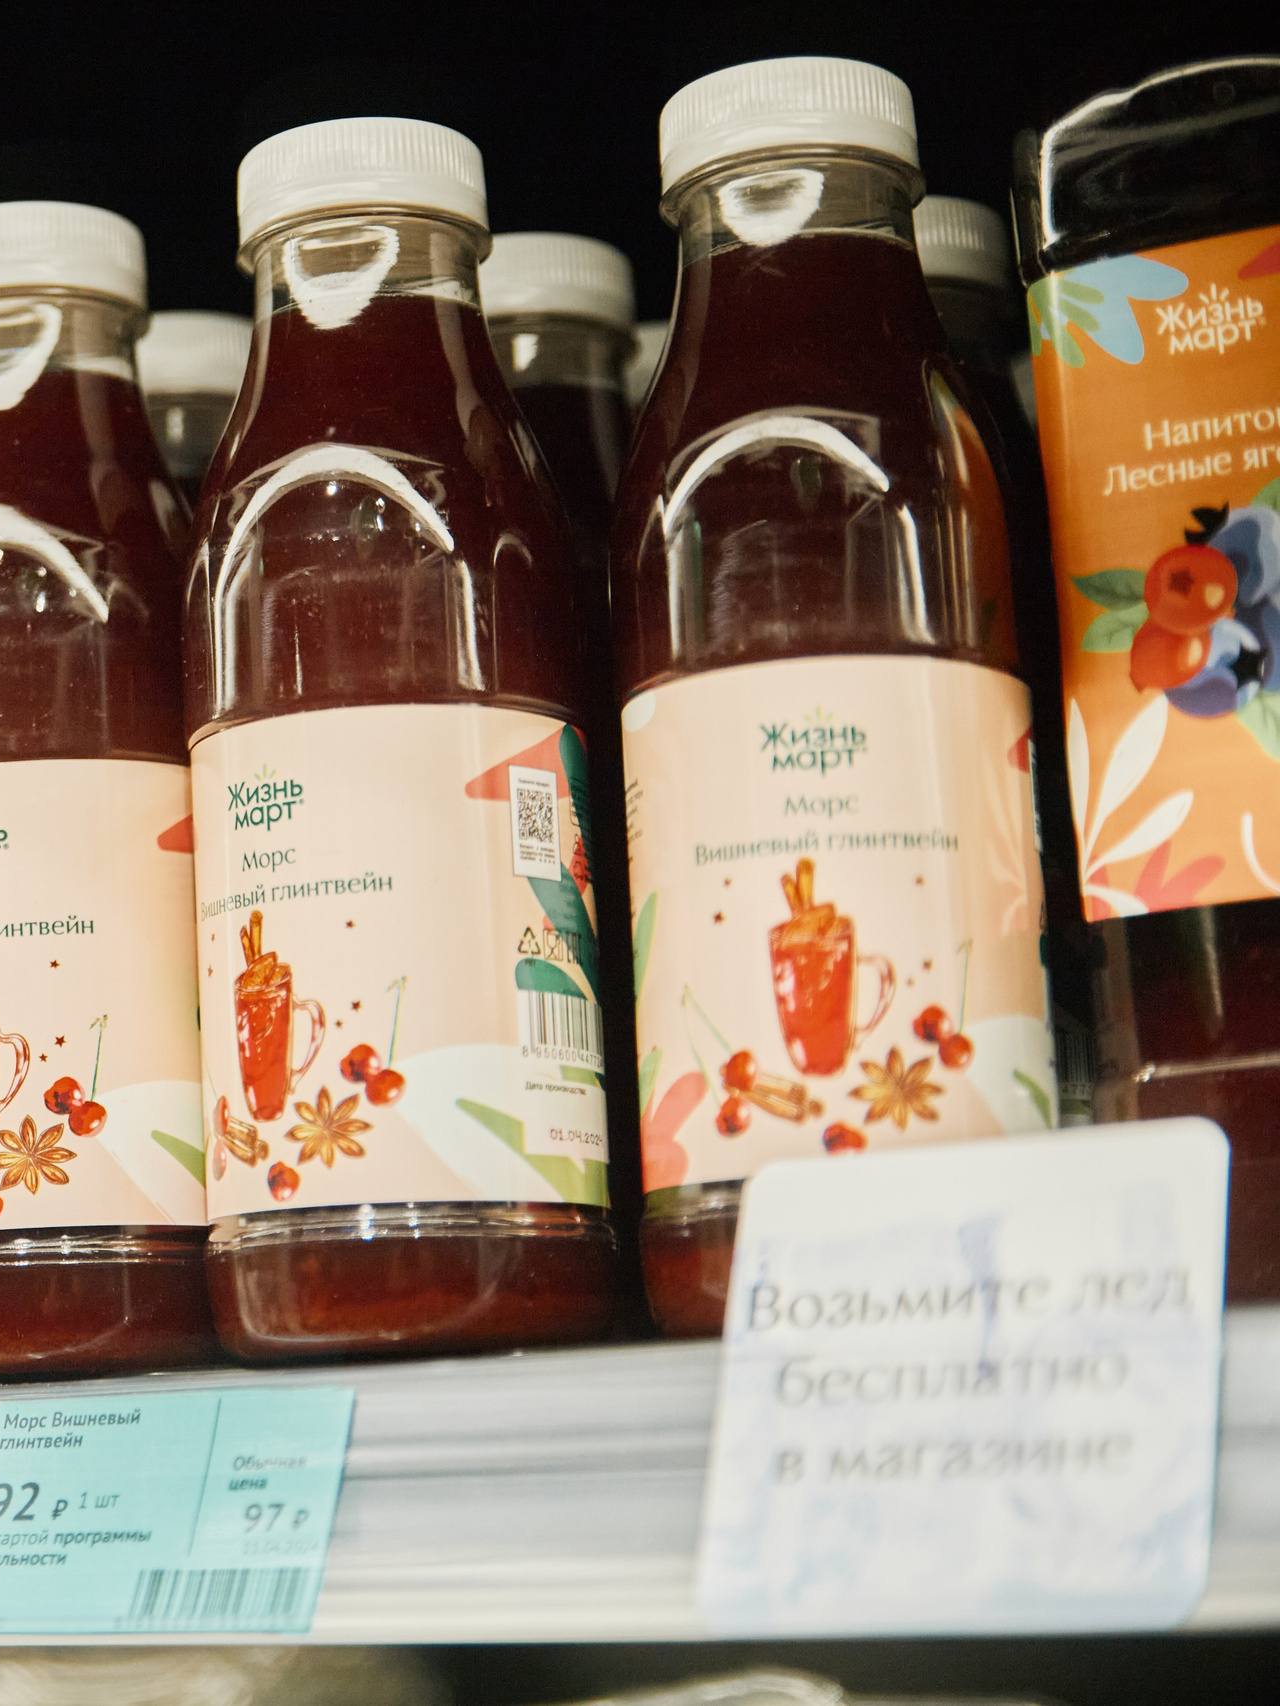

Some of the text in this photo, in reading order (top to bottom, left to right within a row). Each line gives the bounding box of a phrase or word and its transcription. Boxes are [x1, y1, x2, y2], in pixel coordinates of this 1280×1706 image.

[1154, 295, 1264, 336] Жизнь
[1169, 318, 1258, 355] март
[1142, 406, 1280, 451] Напито
[1102, 443, 1280, 497] Лесные яг
[759, 721, 868, 752] Жизнь
[771, 747, 857, 777] март
[227, 779, 304, 811] Жизнь
[783, 795, 861, 819] Морс
[234, 800, 298, 832] март
[241, 848, 297, 872] Морс
[694, 828, 959, 866] Вишневый глинтвейн
[200, 871, 394, 922] Вишневый глинтвейн
[550, 1128, 603, 1147] 01.04.202
[746, 1268, 1052, 1333] Возьмите
[774, 1348, 1130, 1409] бесплатно
[3, 1409, 141, 1432] Морс Вишневый
[0, 1433, 84, 1450] глинтвейн
[228, 1477, 268, 1492] цена
[77, 1492, 88, 1509] 1
[94, 1493, 121, 1510] шт
[244, 1502, 286, 1534] 97
[53, 1530, 152, 1548] программы
